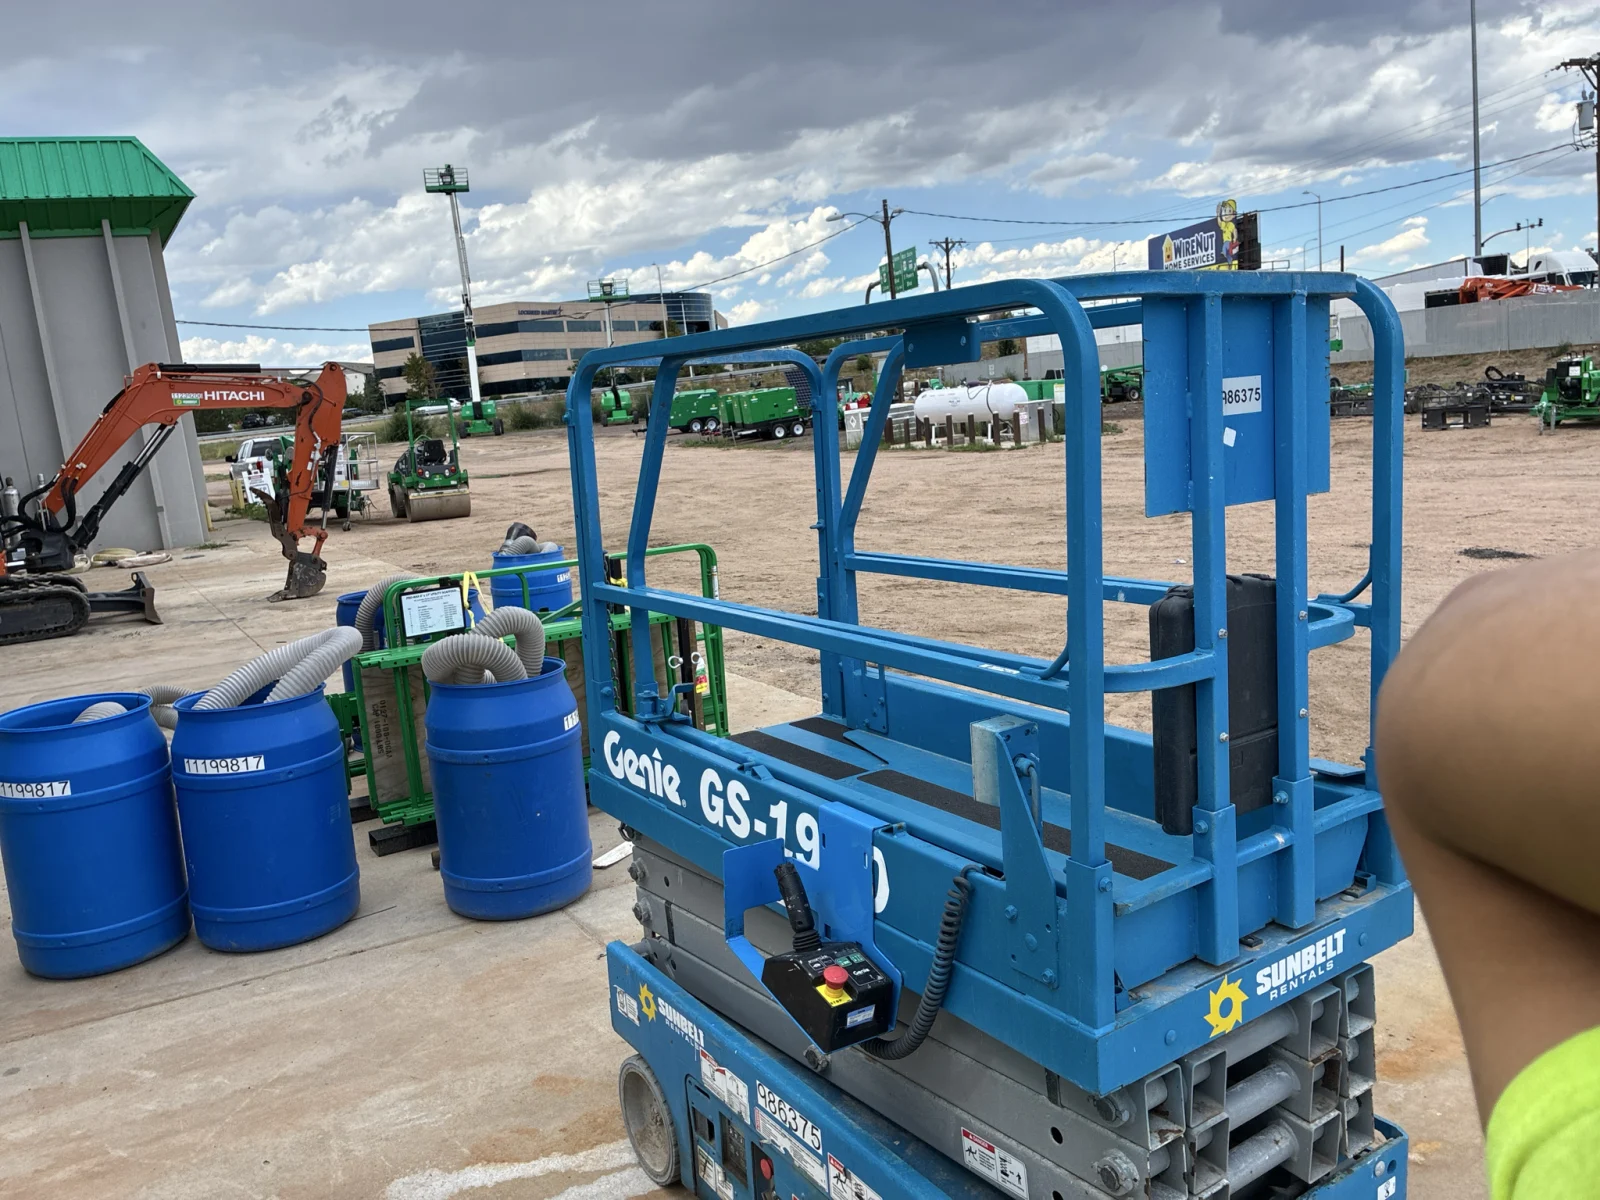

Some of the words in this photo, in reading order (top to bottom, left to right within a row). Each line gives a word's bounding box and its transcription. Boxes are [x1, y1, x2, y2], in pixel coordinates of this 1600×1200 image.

[1165, 261, 1182, 270] HOME
[1184, 252, 1215, 269] SERVICES
[204, 390, 265, 401] HITACHI
[186, 756, 264, 774] 11199817
[604, 730, 683, 808] Genie
[1256, 928, 1347, 996] SUNBELT
[1269, 960, 1334, 1001] RENTALS
[757, 1082, 821, 1151] 986375
